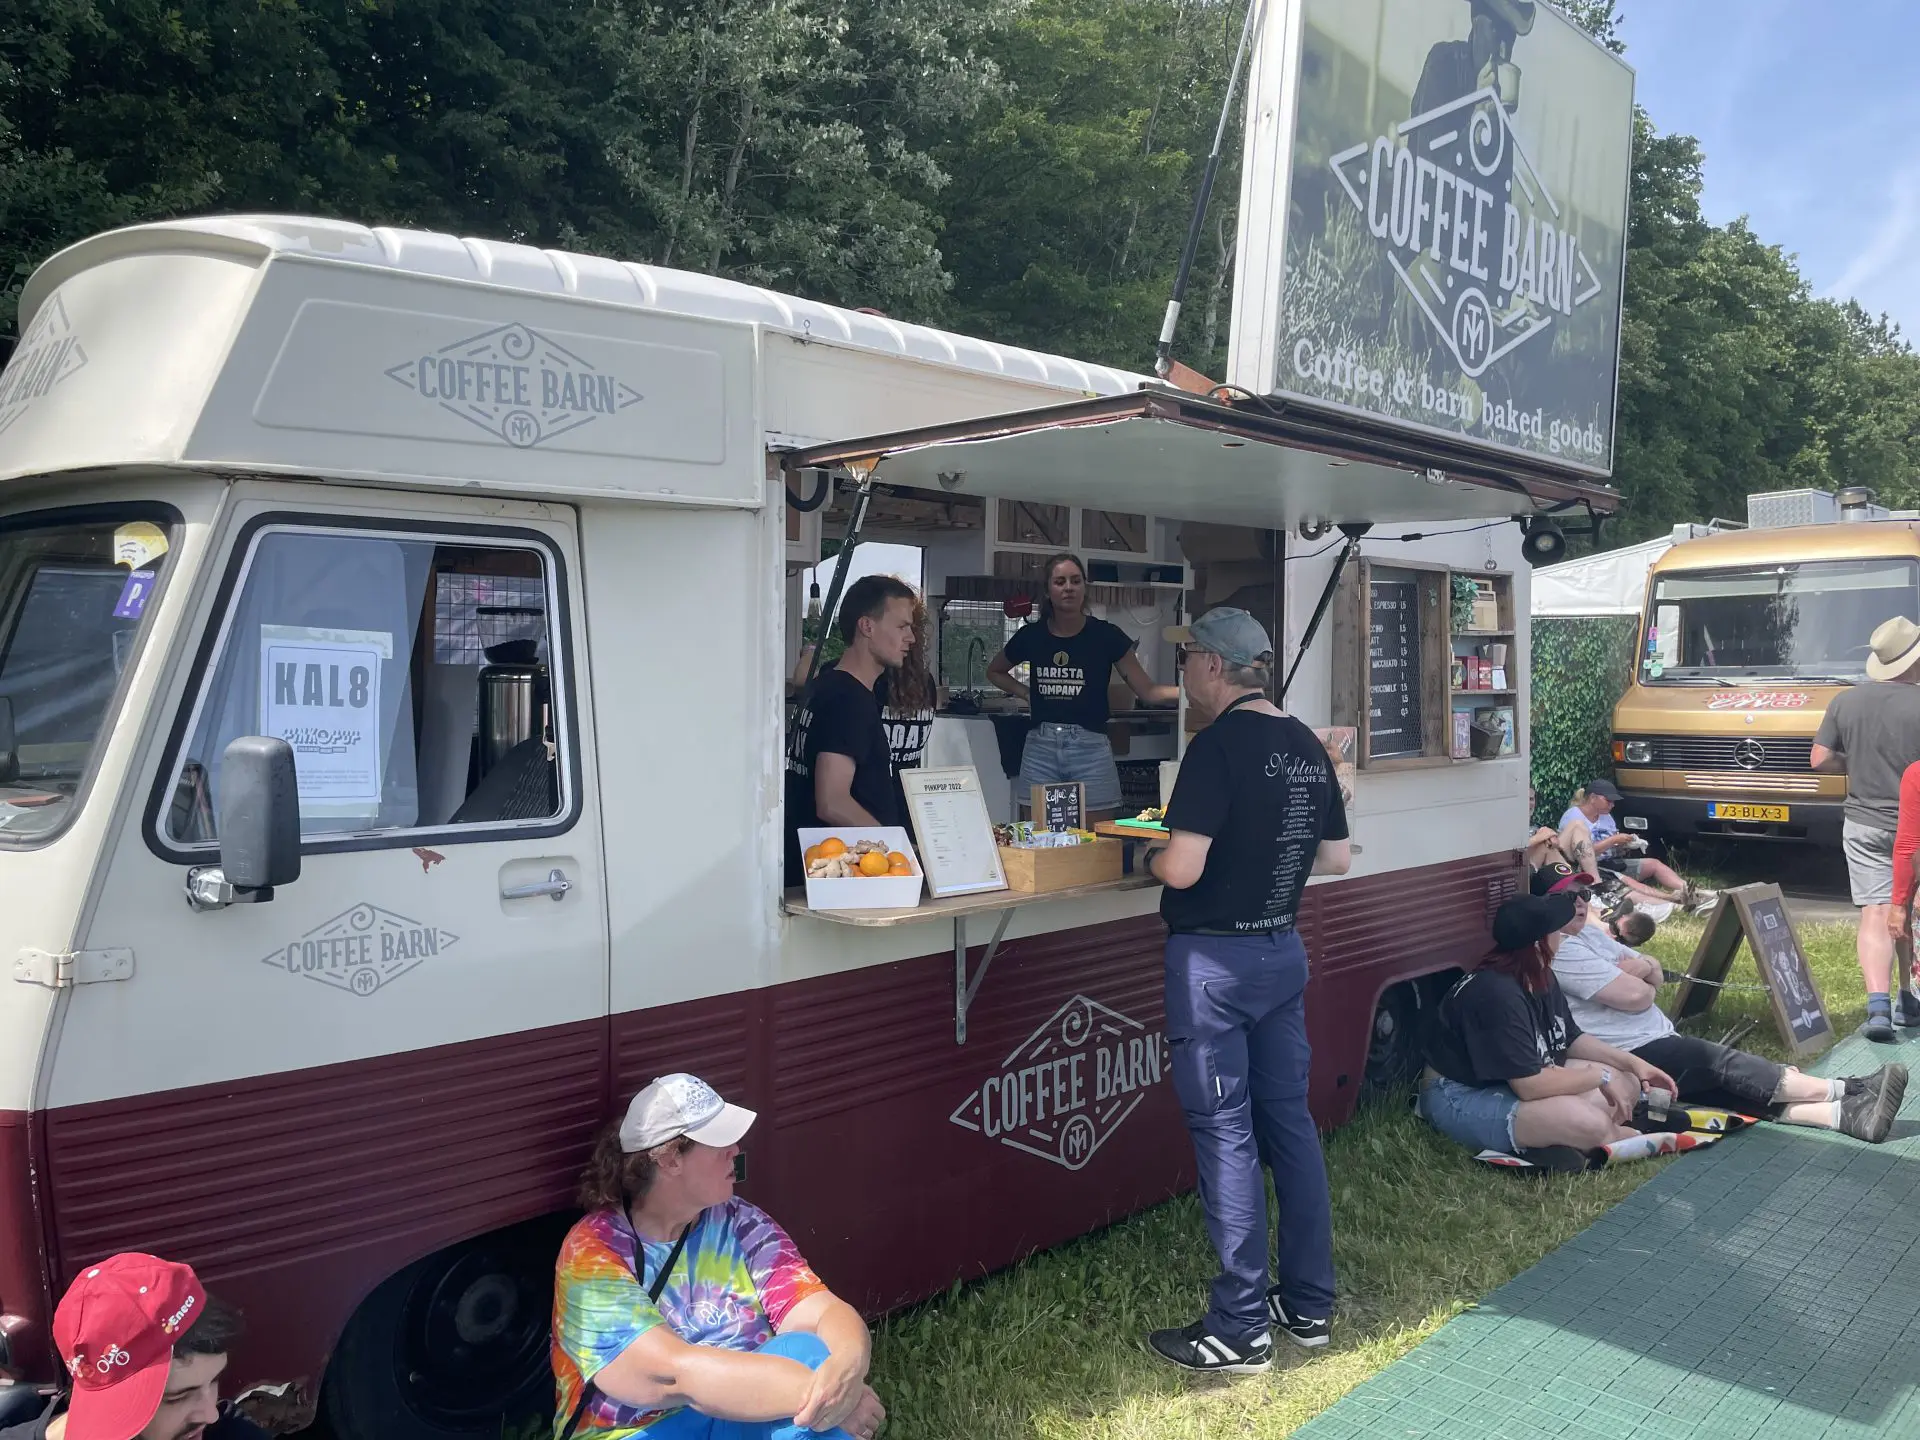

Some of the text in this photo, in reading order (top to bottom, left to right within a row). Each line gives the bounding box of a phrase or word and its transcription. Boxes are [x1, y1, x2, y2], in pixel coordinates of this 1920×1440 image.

[1367, 135, 1577, 316] COFFEE BARN
[418, 355, 616, 415] COFFEE BARN
[1292, 337, 1604, 455] Coffee & barn baked goods
[275, 662, 370, 709] KAL8
[1036, 666, 1084, 679] BARISTA
[1038, 684, 1083, 696] COMPANY
[924, 782, 962, 792] PINKPOP 2022
[1720, 804, 1782, 819] 73-BLX-3
[1235, 920, 1252, 931] WE
[1252, 918, 1273, 930] WERE
[286, 927, 439, 974] COFFEE BARN
[982, 1031, 1162, 1138] COFFEE BARN
[168, 1295, 195, 1326] Eneco
